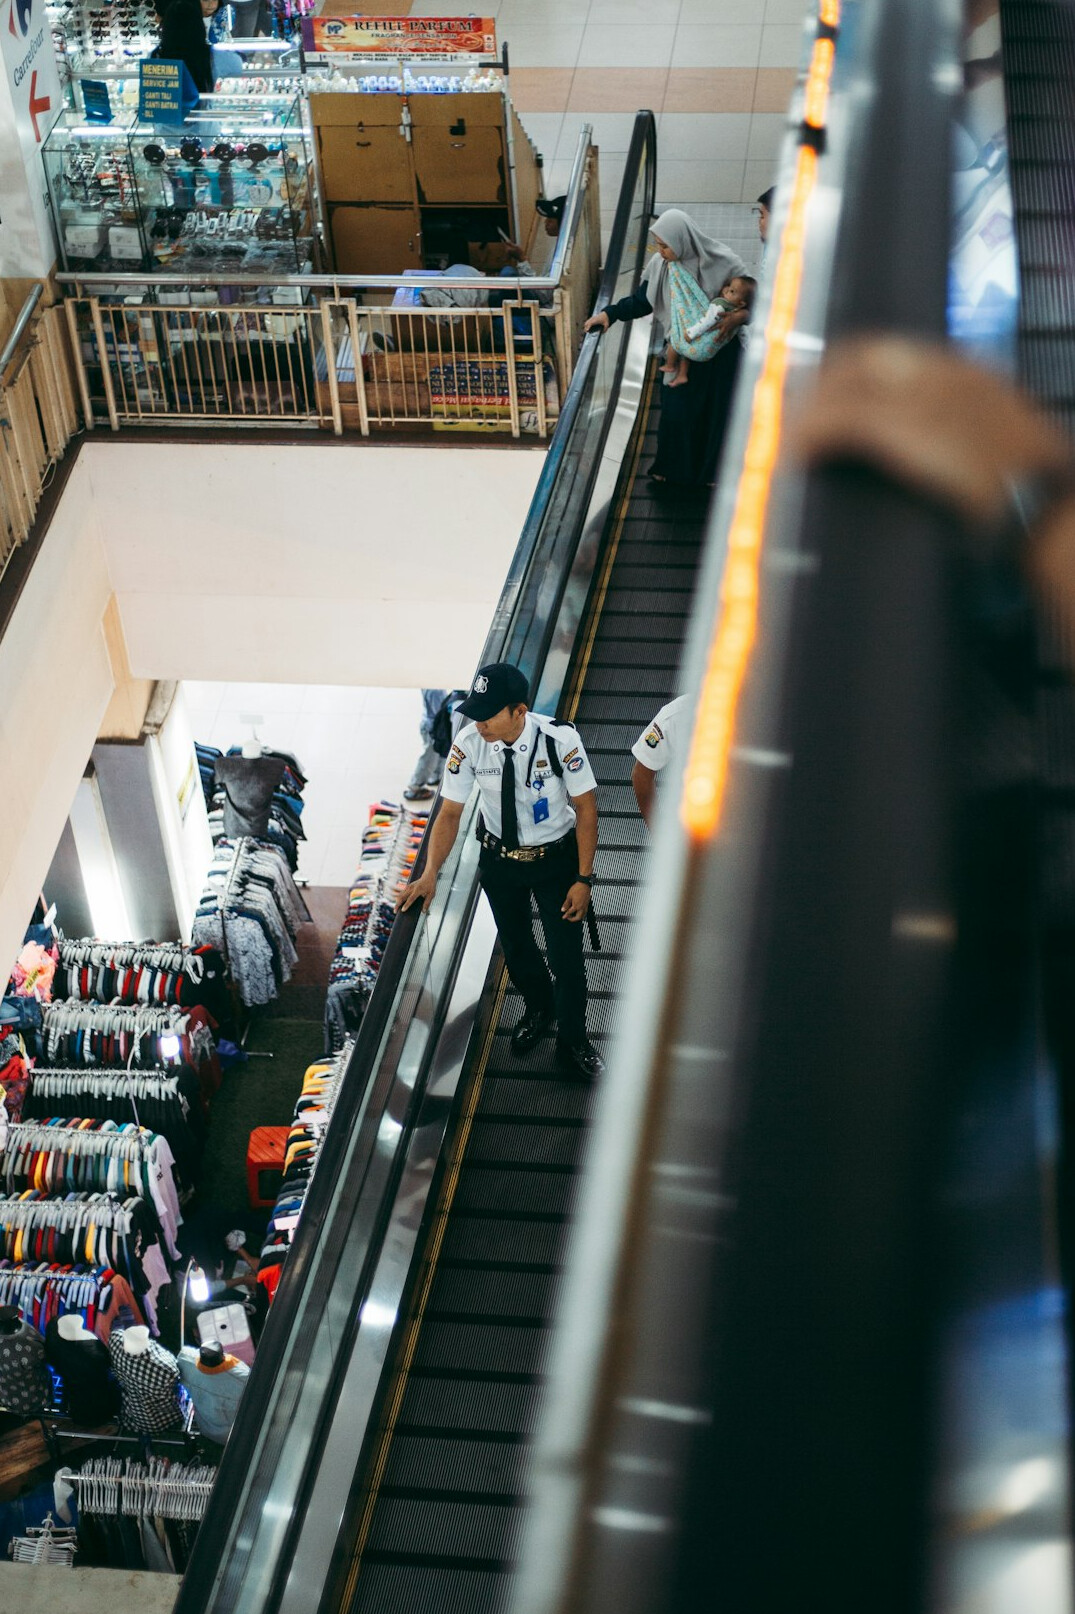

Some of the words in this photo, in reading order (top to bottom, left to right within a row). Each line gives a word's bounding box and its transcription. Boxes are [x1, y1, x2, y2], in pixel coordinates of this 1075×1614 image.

[409, 21, 473, 31] PARFUM
[13, 28, 44, 87] Carrefour
[142, 64, 179, 75] MENERIMA
[142, 79, 166, 87] SERVICE
[167, 80, 179, 88] JAM
